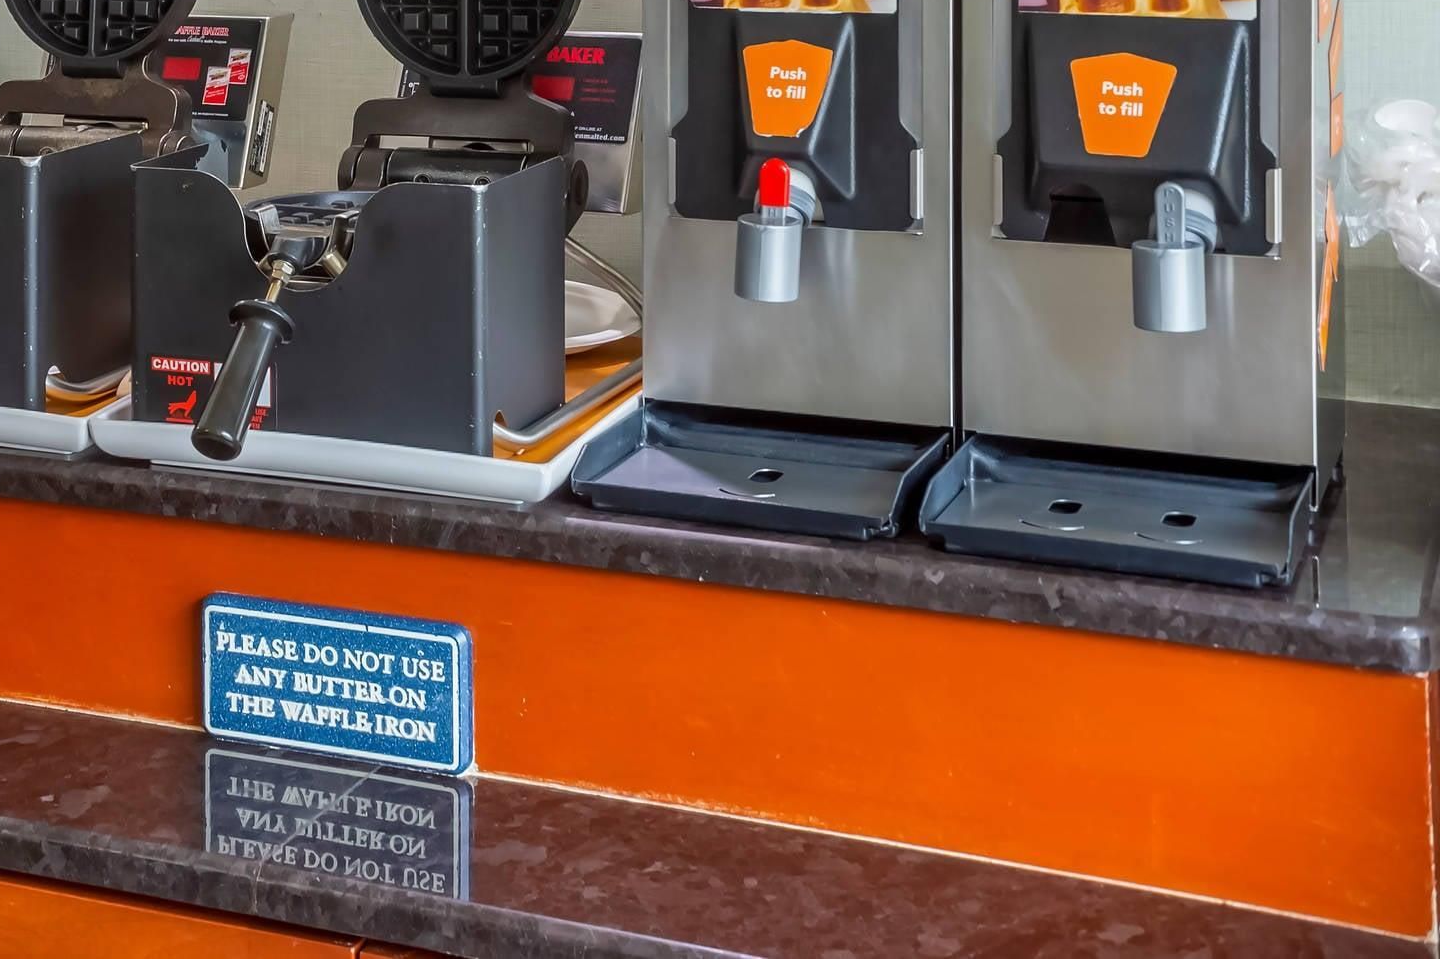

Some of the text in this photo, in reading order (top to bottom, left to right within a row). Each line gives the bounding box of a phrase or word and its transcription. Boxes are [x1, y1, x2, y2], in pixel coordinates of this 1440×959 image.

[770, 66, 807, 81] Push
[766, 84, 806, 99] to fill
[1101, 81, 1143, 97] Push
[1098, 101, 1143, 117] to fill
[574, 132, 625, 142] enmalted.com
[152, 358, 209, 373] CAUTION
[168, 375, 193, 386] HOT
[216, 631, 445, 682] PLEASE DO NOT USE
[234, 664, 426, 710] ANY BUTTER ON
[226, 692, 437, 743] THE WAFFLE IRON
